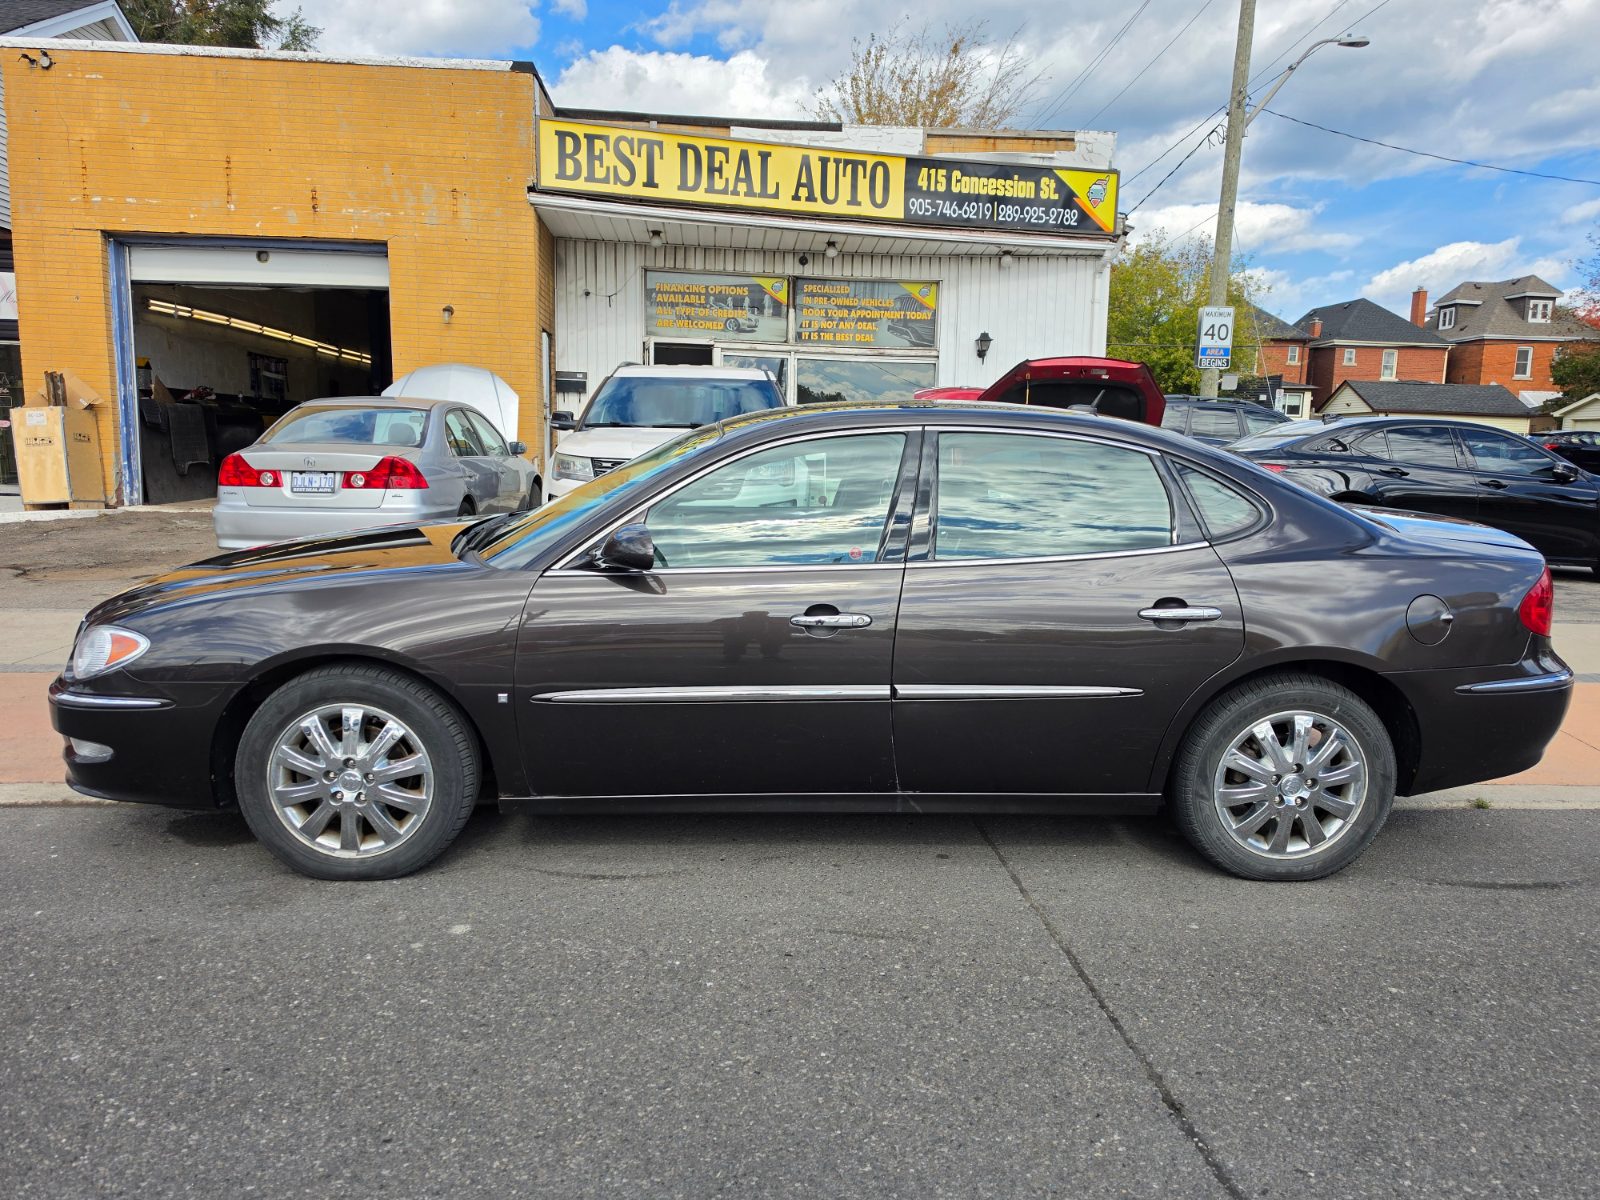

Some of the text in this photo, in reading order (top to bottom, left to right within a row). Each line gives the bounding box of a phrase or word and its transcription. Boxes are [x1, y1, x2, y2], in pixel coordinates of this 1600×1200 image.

[554, 129, 891, 209] BEST DEAL AUTO
[917, 167, 1059, 200] 415 Concession St.
[655, 282, 749, 296] FINANCING OPTIONS
[803, 284, 851, 295] SPECIALIZED
[656, 293, 706, 304] AVAILABLE
[802, 296, 895, 307] IN PRE-OWNED VEHICLES
[656, 306, 748, 319] ALL TYPE OF CREDITS
[802, 308, 932, 320] BOOK YOUR APPOINTMENT TODAY
[656, 319, 724, 330] ARE WELCOMED
[802, 320, 809, 328] IT
[811, 320, 819, 328] IS
[820, 321, 838, 329] NOT
[839, 321, 856, 330] ANY
[801, 331, 809, 340] IT
[811, 332, 819, 340] IS
[820, 332, 834, 341] THE
[835, 332, 853, 341] BEST
[1203, 323, 1229, 341] 40
[1201, 358, 1227, 367] BEGINS
